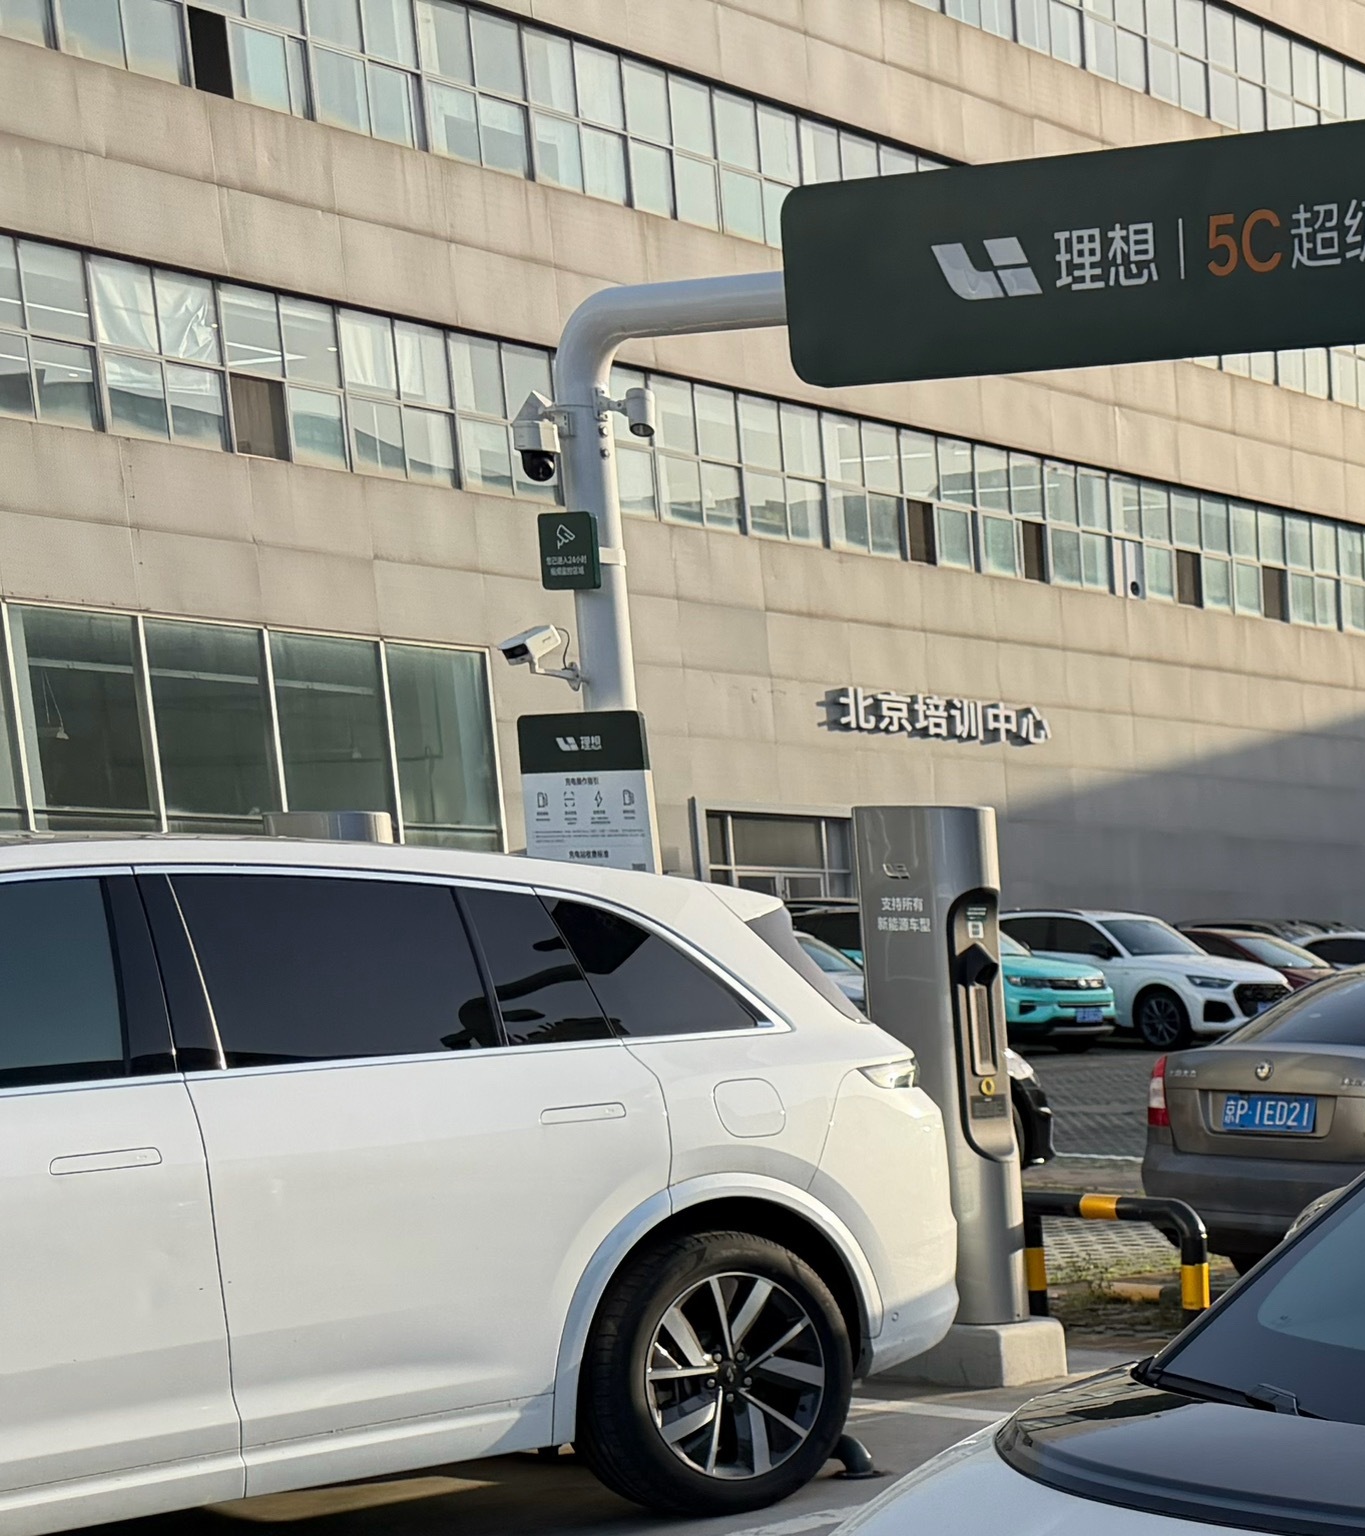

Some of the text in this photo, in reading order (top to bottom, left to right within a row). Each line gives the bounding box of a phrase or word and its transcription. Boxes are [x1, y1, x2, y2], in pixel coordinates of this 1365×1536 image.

[1053, 222, 1158, 291] 理想
[838, 685, 1053, 745] 北京培训中心
[580, 735, 602, 750] 理想
[881, 897, 924, 912] 支持所有
[877, 917, 931, 932] 新能源车型
